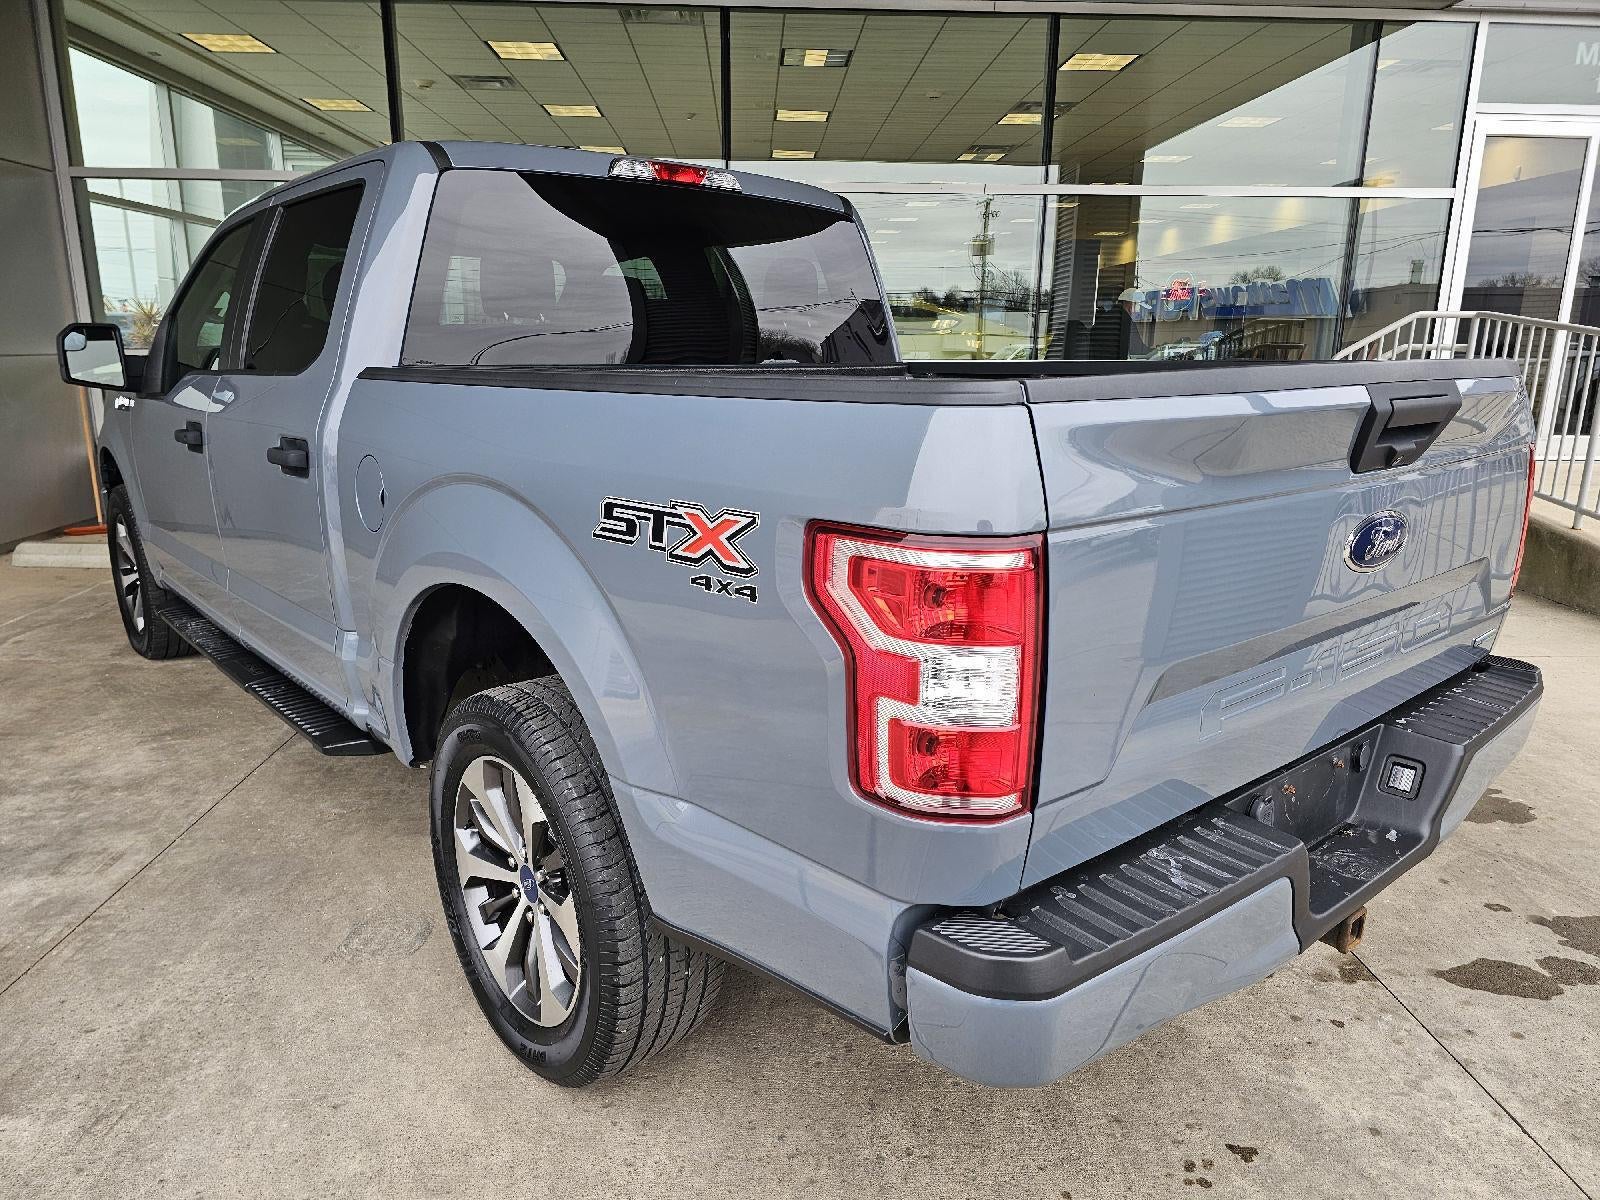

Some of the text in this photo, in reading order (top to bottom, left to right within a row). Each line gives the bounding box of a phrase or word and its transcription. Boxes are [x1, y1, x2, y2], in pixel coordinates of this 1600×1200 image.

[1575, 41, 1600, 66] M
[592, 496, 760, 579] STX
[1199, 599, 1452, 742] F-150
